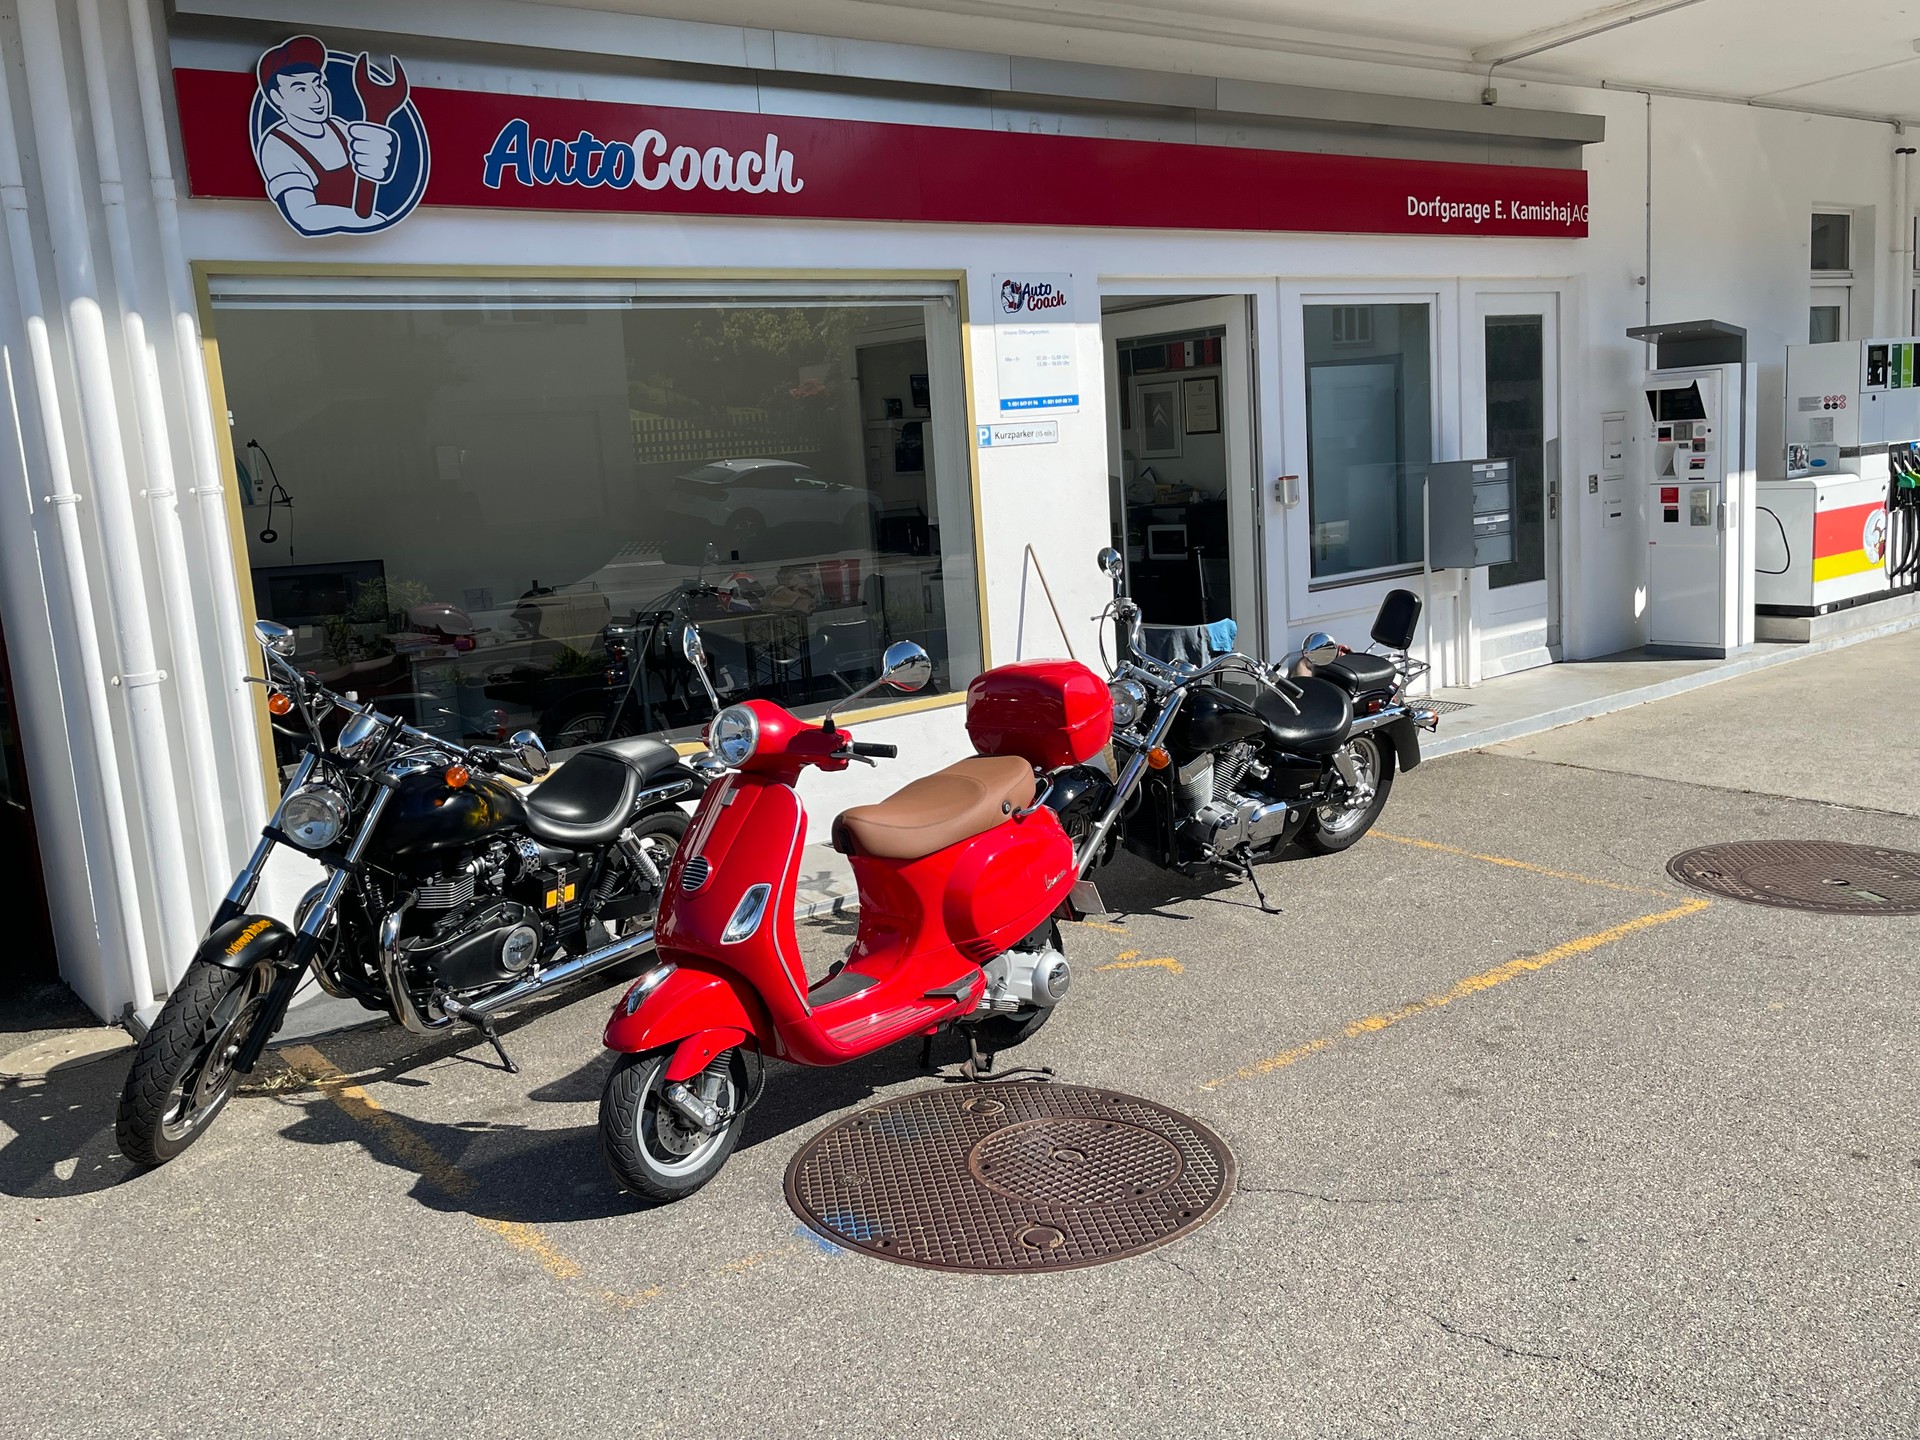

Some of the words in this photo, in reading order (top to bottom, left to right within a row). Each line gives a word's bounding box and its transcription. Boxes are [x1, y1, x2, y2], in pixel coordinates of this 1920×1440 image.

[1407, 196, 1490, 223] Dorfgarage
[1494, 200, 1506, 219] E.
[1022, 282, 1052, 300] Auto
[1027, 290, 1067, 311] Coach
[1877, 366, 1883, 382] 1
[979, 427, 989, 445] P
[994, 430, 1034, 440] Kurzparker
